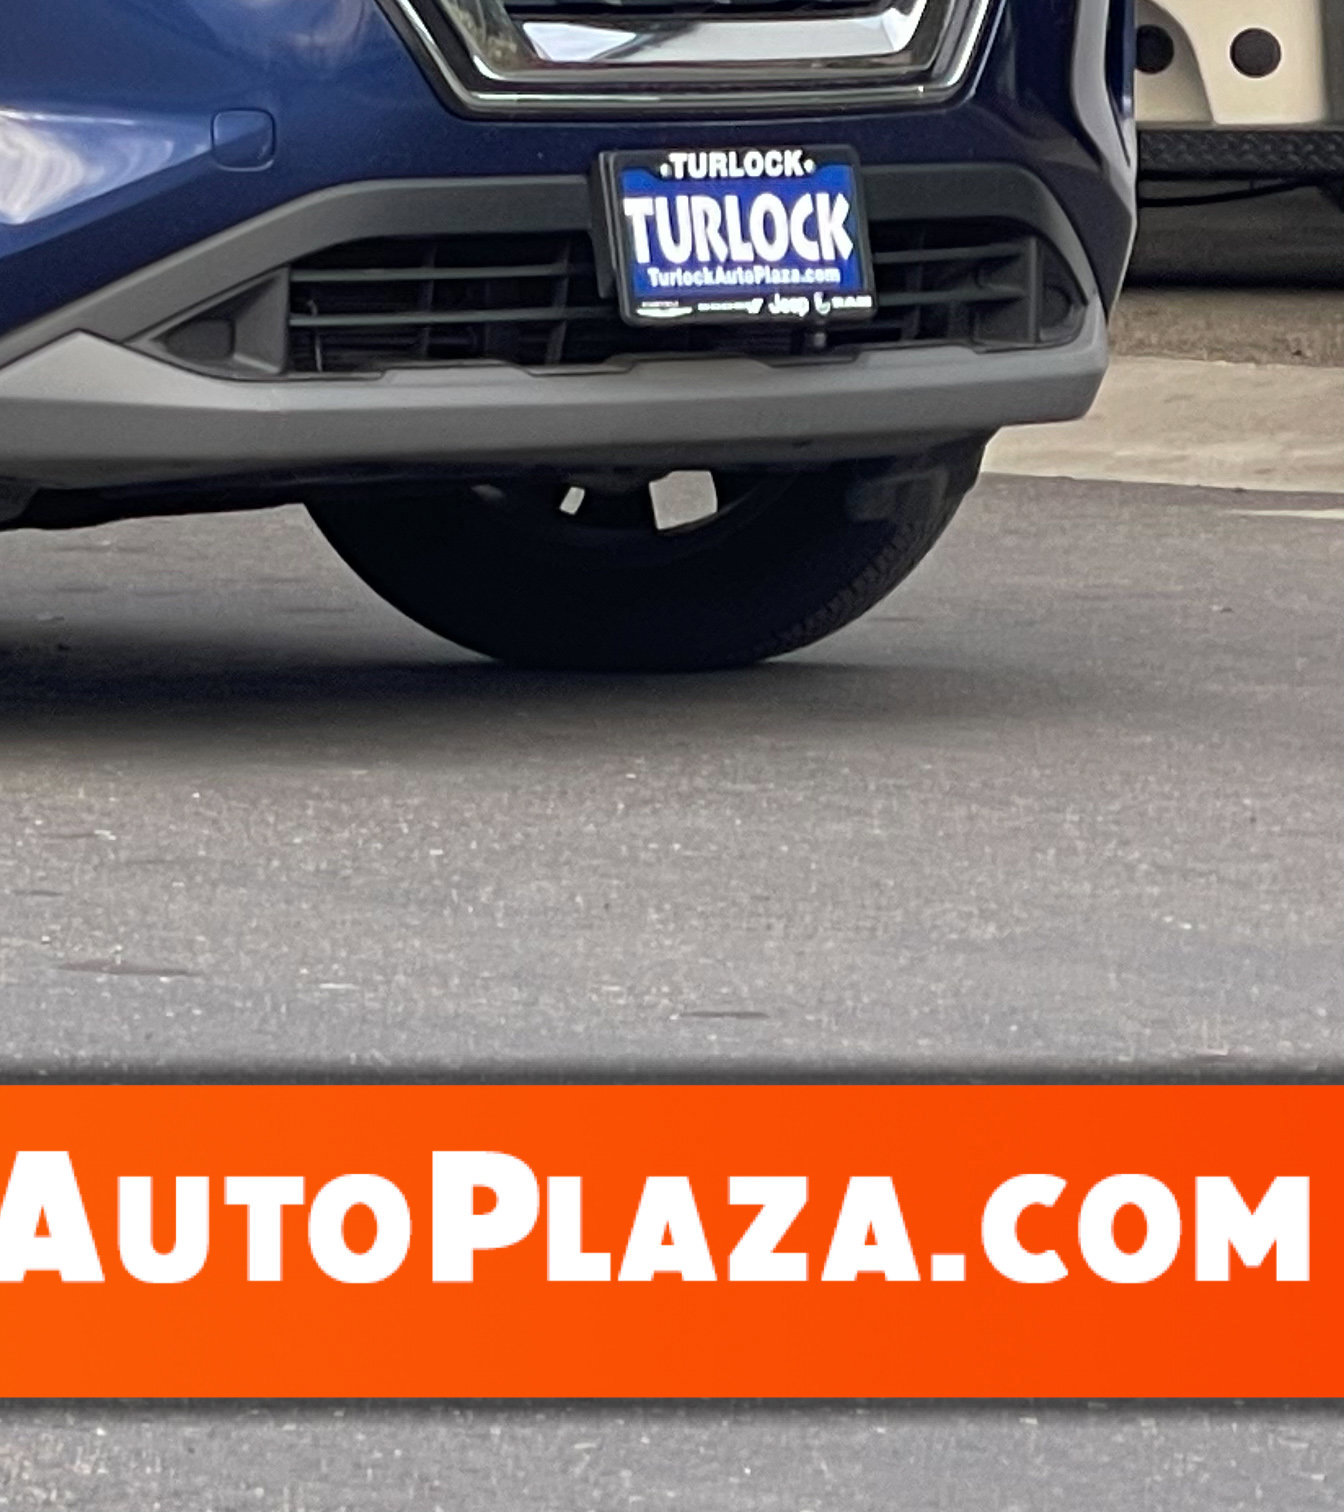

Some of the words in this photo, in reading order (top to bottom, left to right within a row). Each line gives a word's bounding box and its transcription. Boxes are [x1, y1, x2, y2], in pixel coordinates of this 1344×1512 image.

[668, 149, 805, 179] TURLOCK
[622, 192, 855, 264] TURLOCK
[647, 263, 841, 288] TurlockAutoPlaza.com
